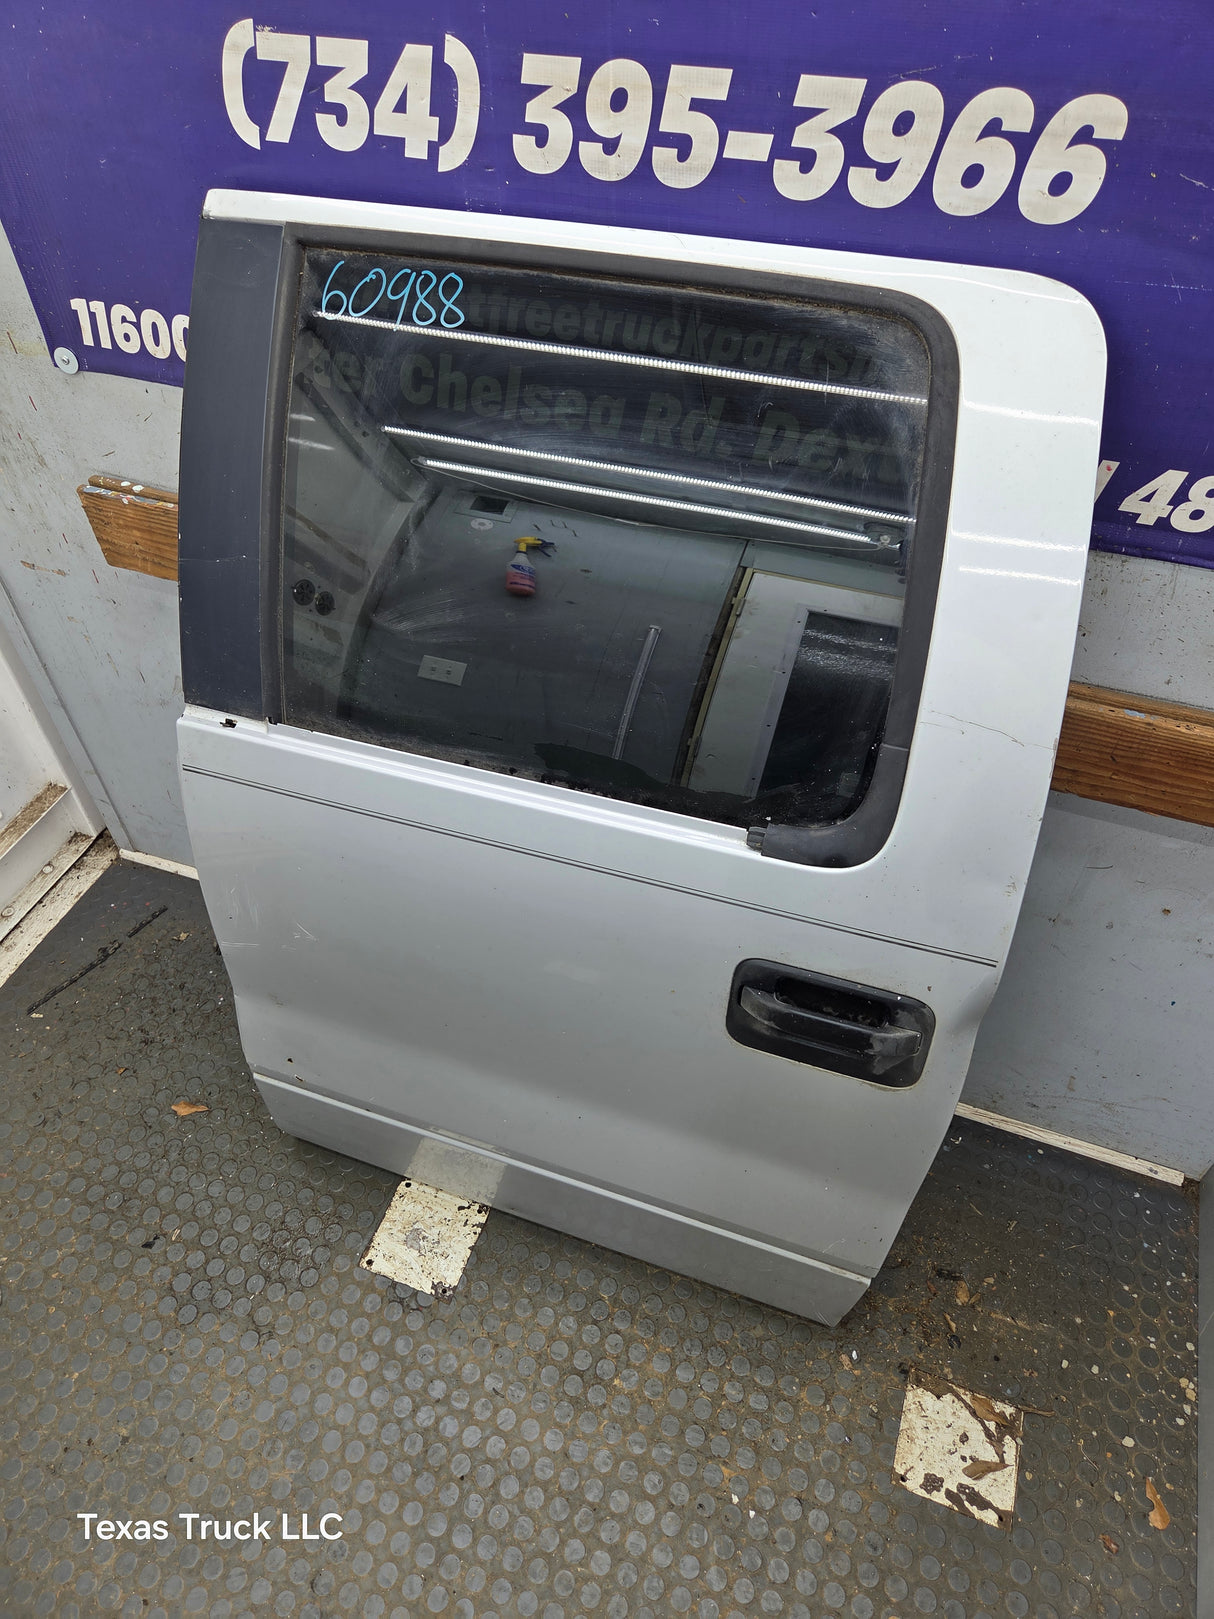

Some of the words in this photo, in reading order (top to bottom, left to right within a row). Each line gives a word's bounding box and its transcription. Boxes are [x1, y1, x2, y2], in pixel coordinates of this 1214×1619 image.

[221, 18, 481, 173] (734)
[511, 52, 1129, 226] 395-3966
[322, 261, 466, 332] 60988
[400, 351, 622, 442] Chelsea
